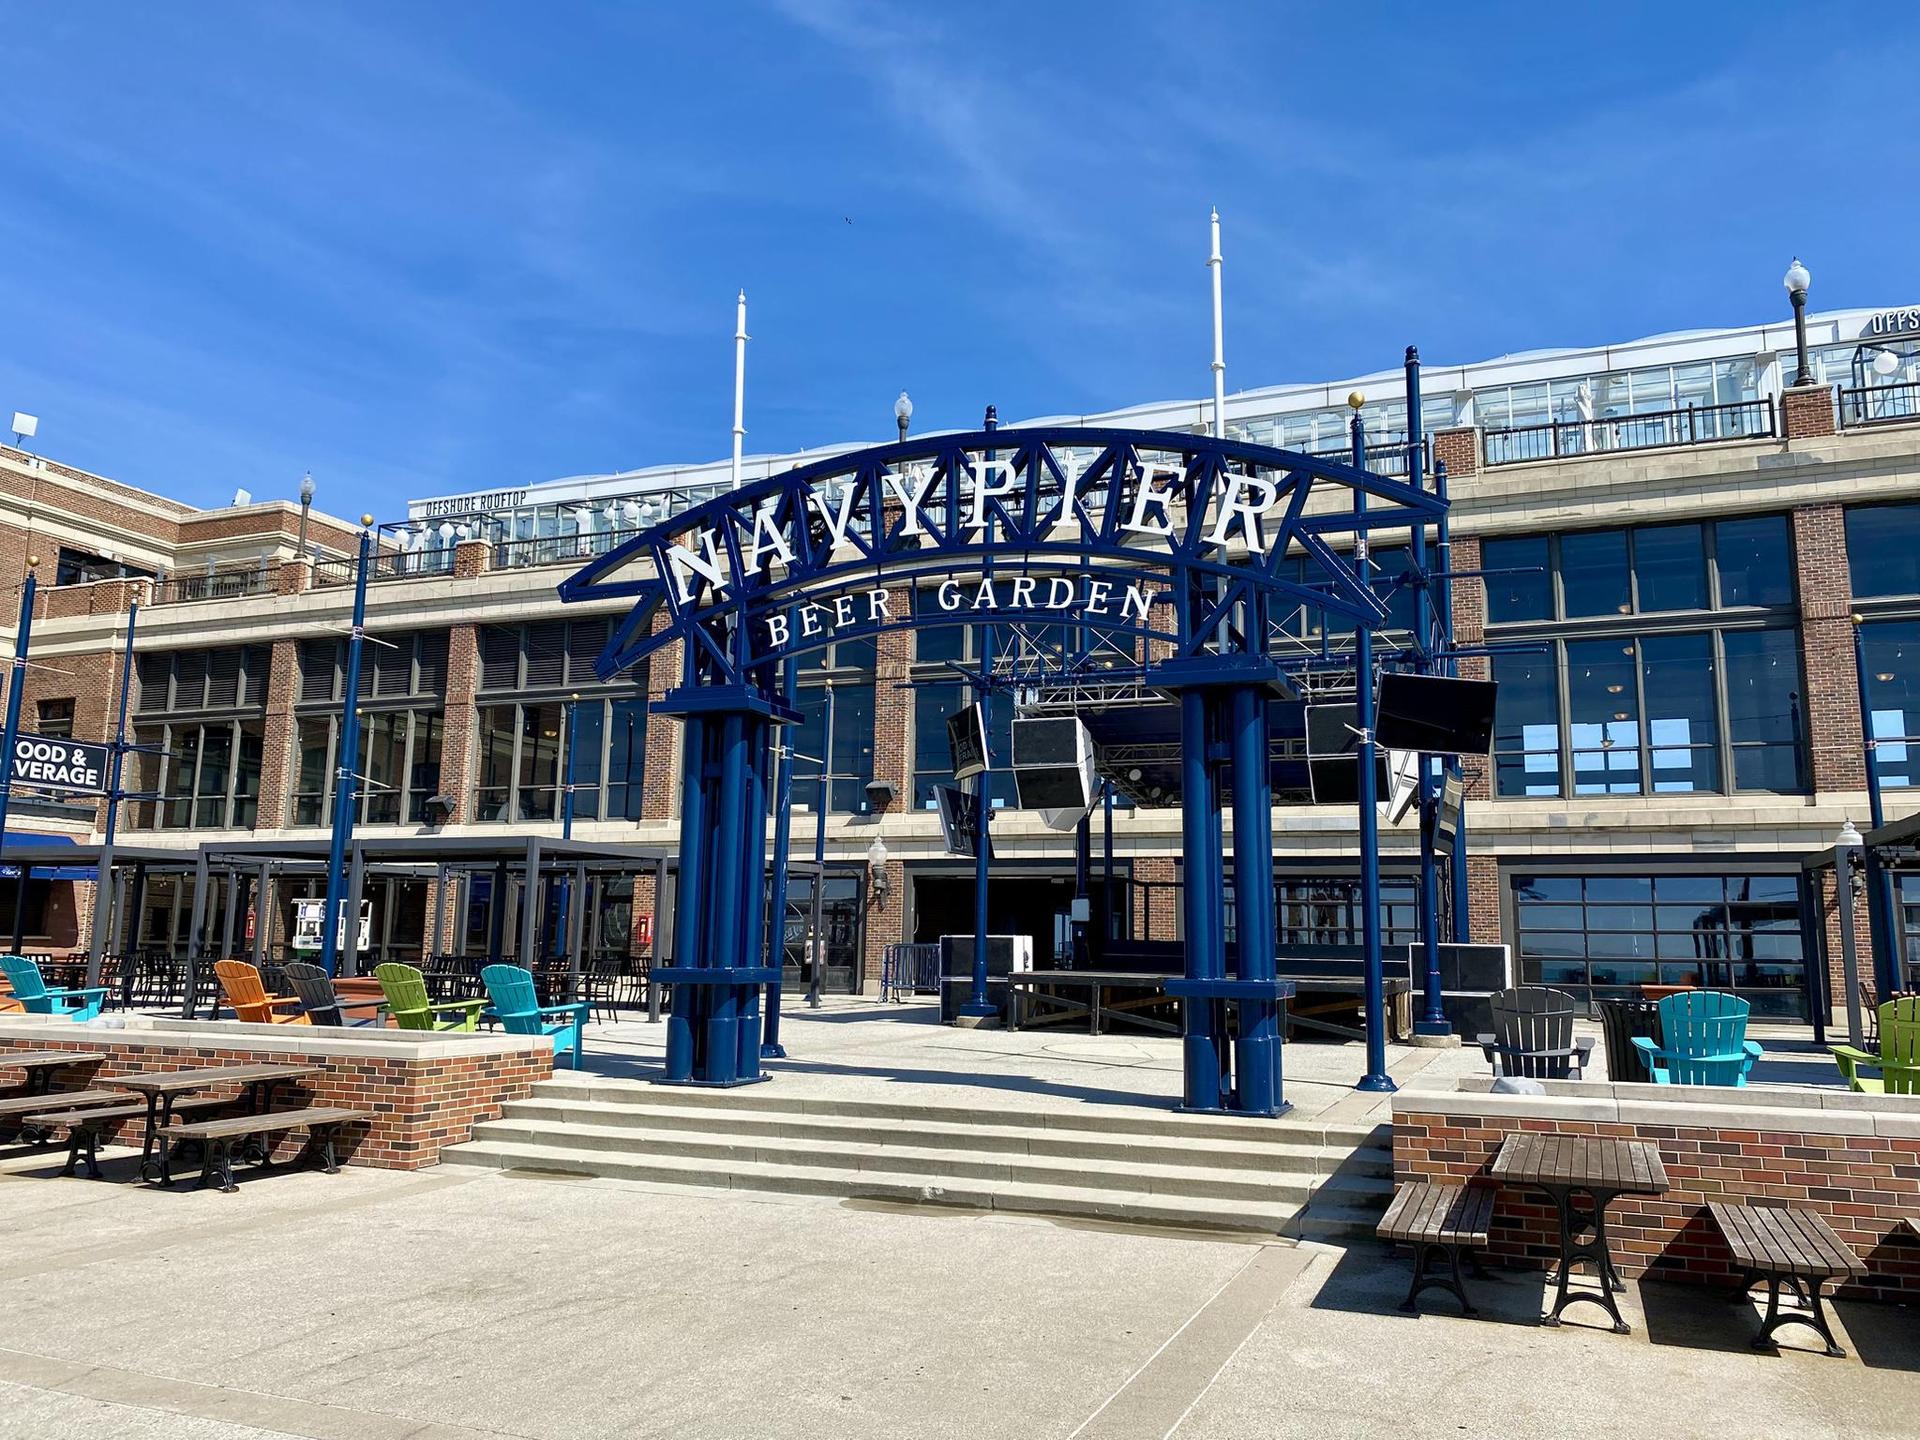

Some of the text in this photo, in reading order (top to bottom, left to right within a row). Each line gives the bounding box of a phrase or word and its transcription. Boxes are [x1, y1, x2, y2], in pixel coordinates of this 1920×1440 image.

[425, 490, 526, 516] OFFSHORE ROOFTOP
[764, 577, 1154, 648] BEER GARDEN
[15, 740, 87, 767] OOD &
[12, 759, 97, 785] VERAGE
